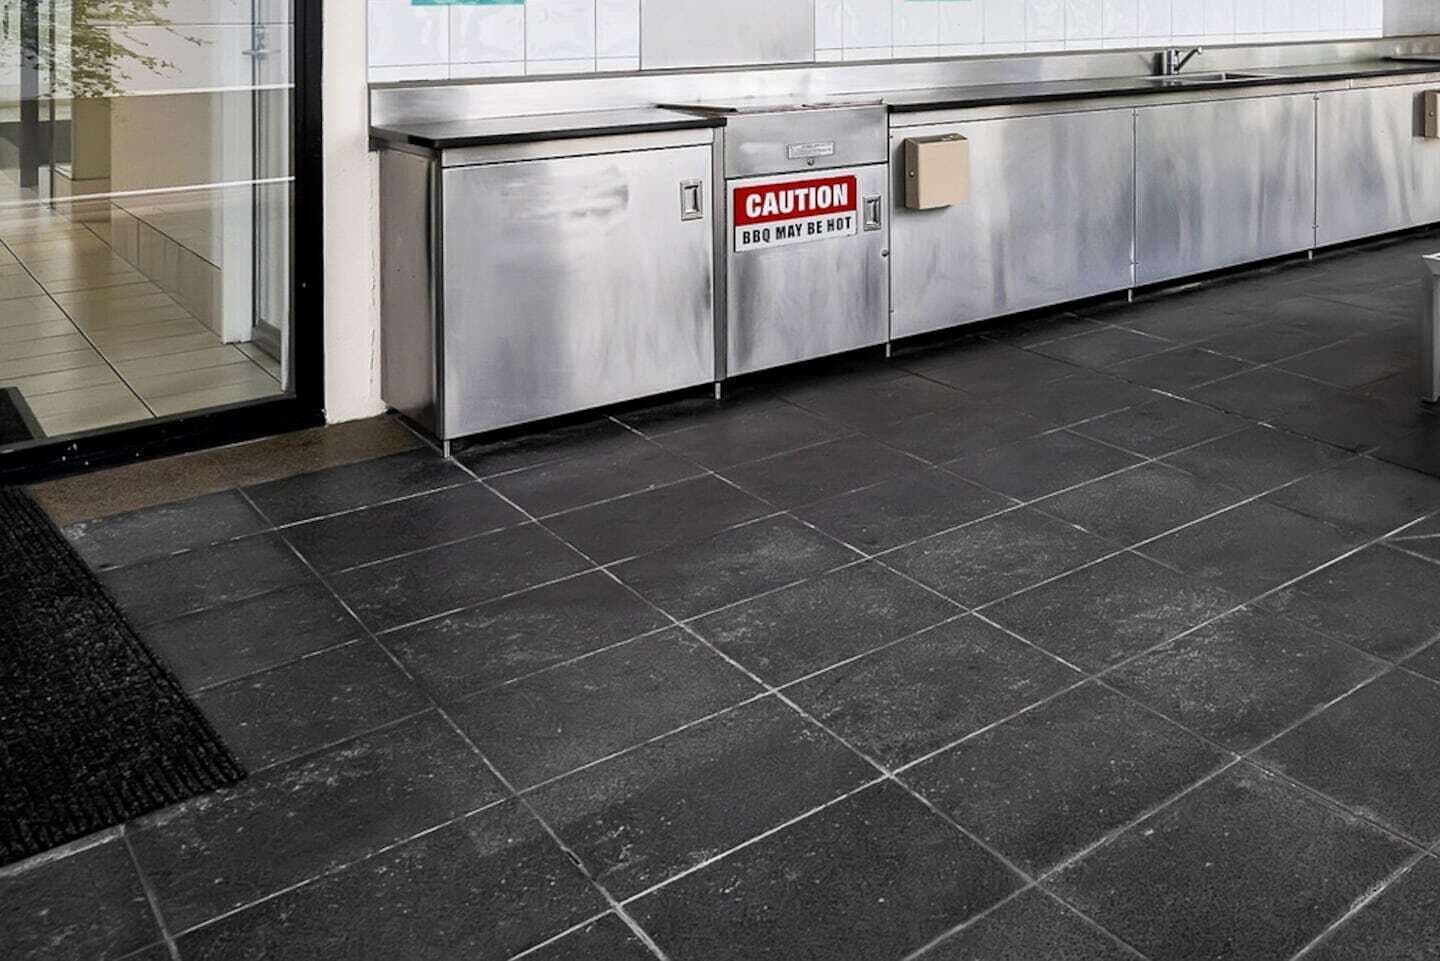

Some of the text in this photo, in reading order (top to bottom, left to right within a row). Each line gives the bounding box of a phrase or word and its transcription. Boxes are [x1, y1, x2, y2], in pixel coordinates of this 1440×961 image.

[745, 183, 849, 218] CAUTION
[743, 216, 851, 245] BBQ MAY BE HOT
